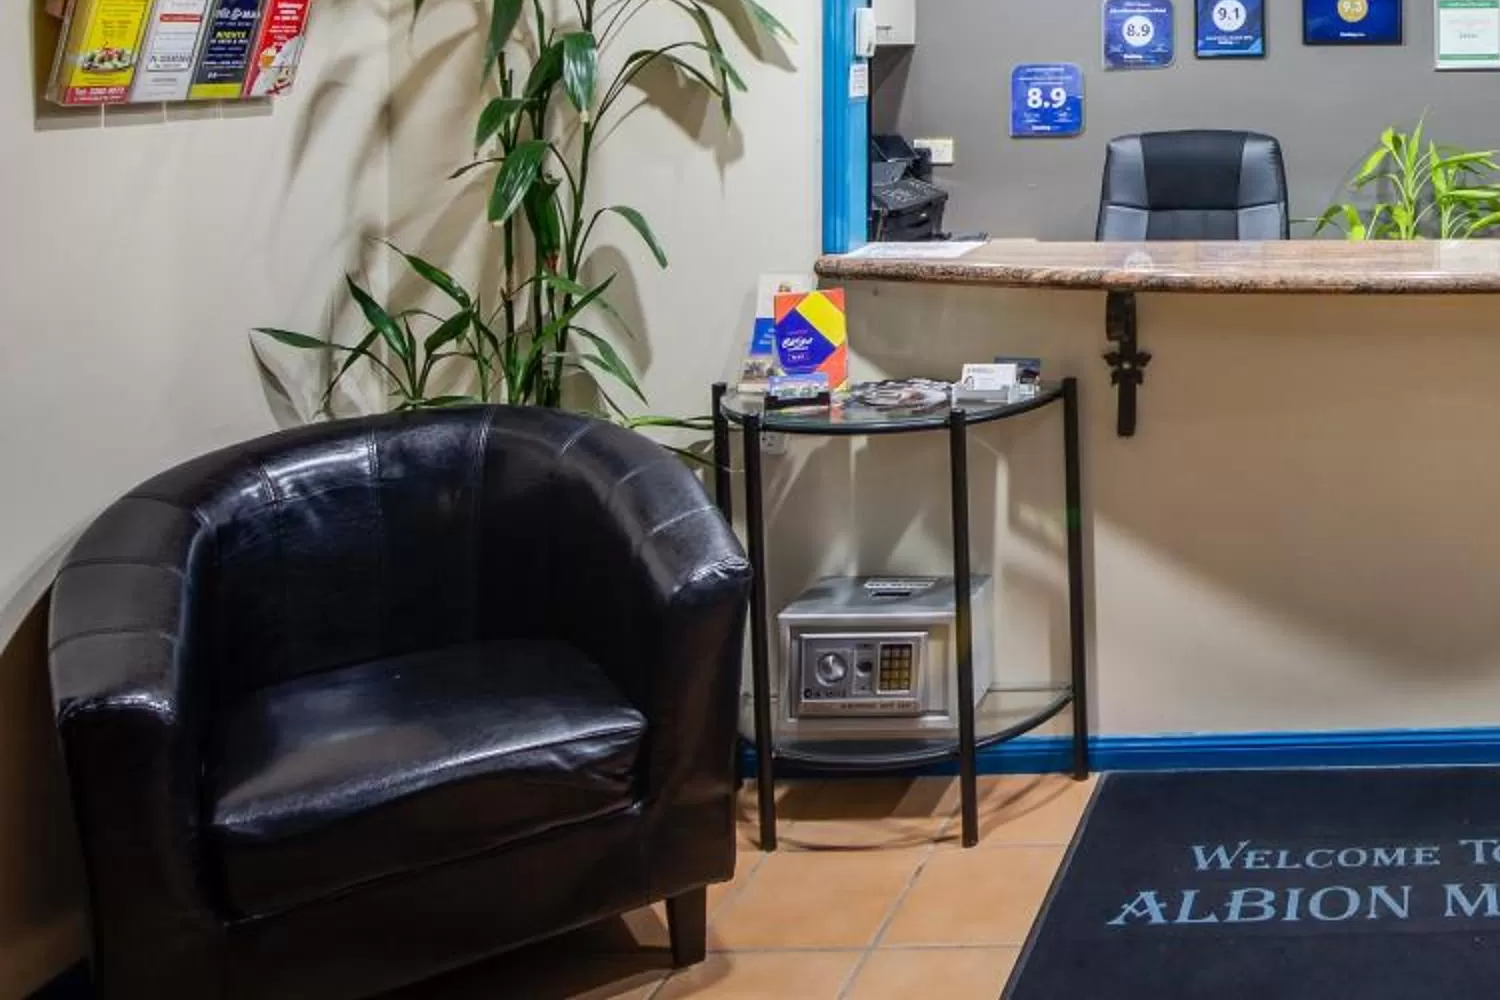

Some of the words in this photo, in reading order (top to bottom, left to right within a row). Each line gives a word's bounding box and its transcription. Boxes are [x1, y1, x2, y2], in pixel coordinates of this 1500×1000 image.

[1217, 7, 1239, 21] 9.1
[1126, 23, 1151, 37] 8.9
[1027, 87, 1067, 109] 8.9
[1106, 885, 1413, 926] ALBION
